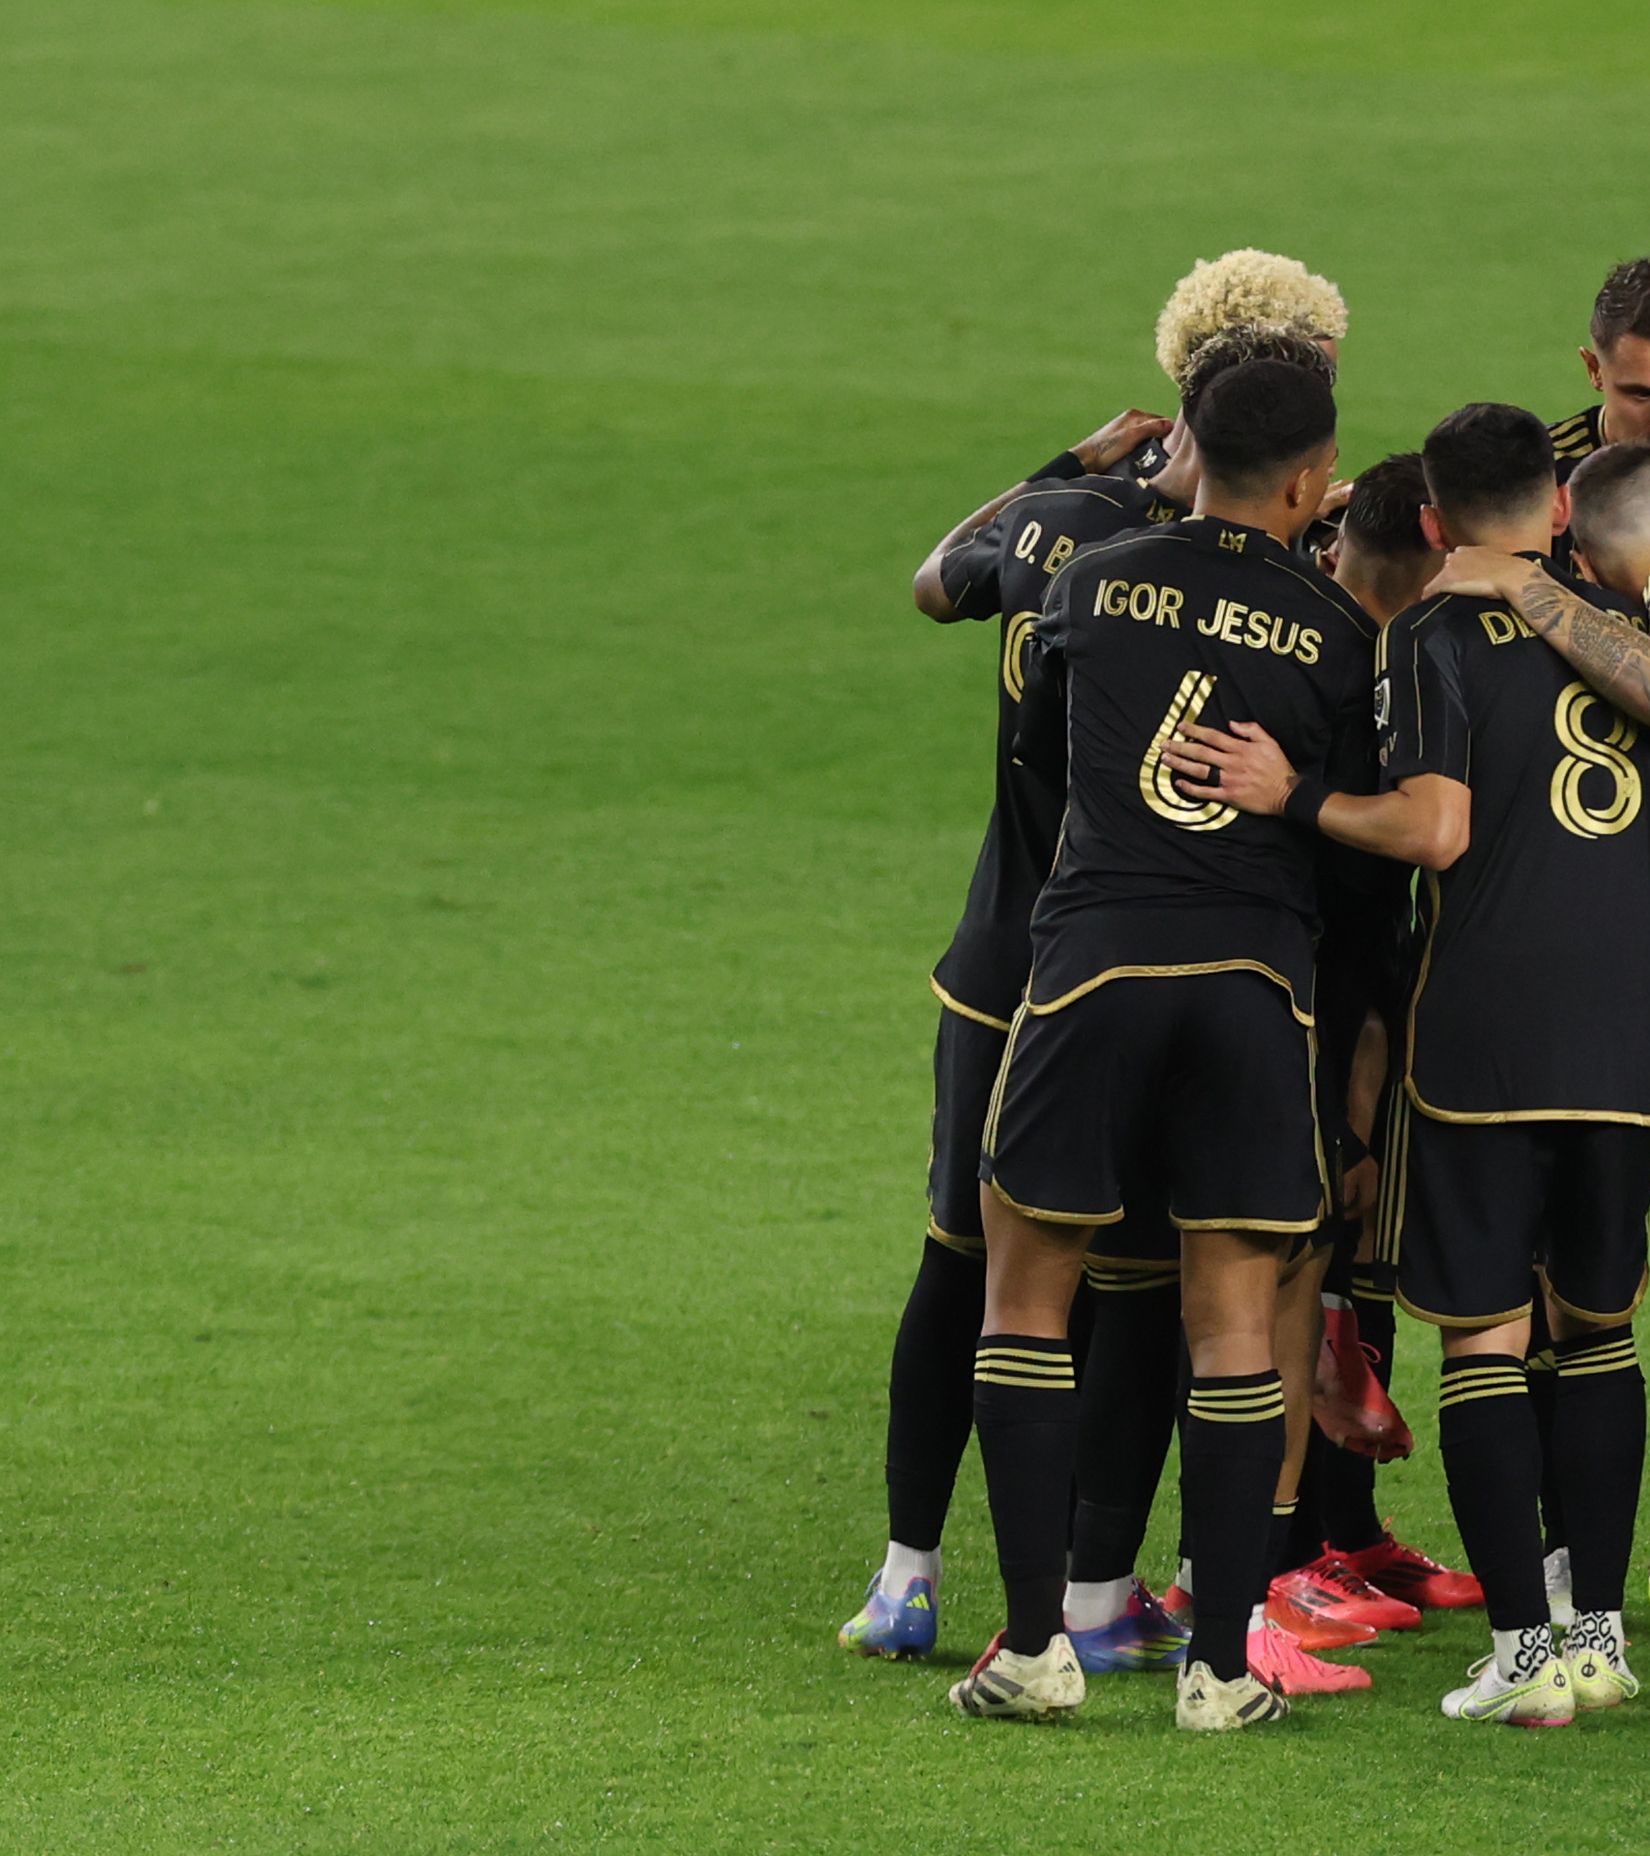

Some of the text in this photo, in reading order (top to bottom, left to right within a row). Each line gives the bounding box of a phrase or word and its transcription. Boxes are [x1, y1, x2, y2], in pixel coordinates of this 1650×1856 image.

[1093, 578, 1323, 665] IGOR JESUS
[1139, 670, 1240, 832] 6
[1550, 680, 1643, 840] 8
